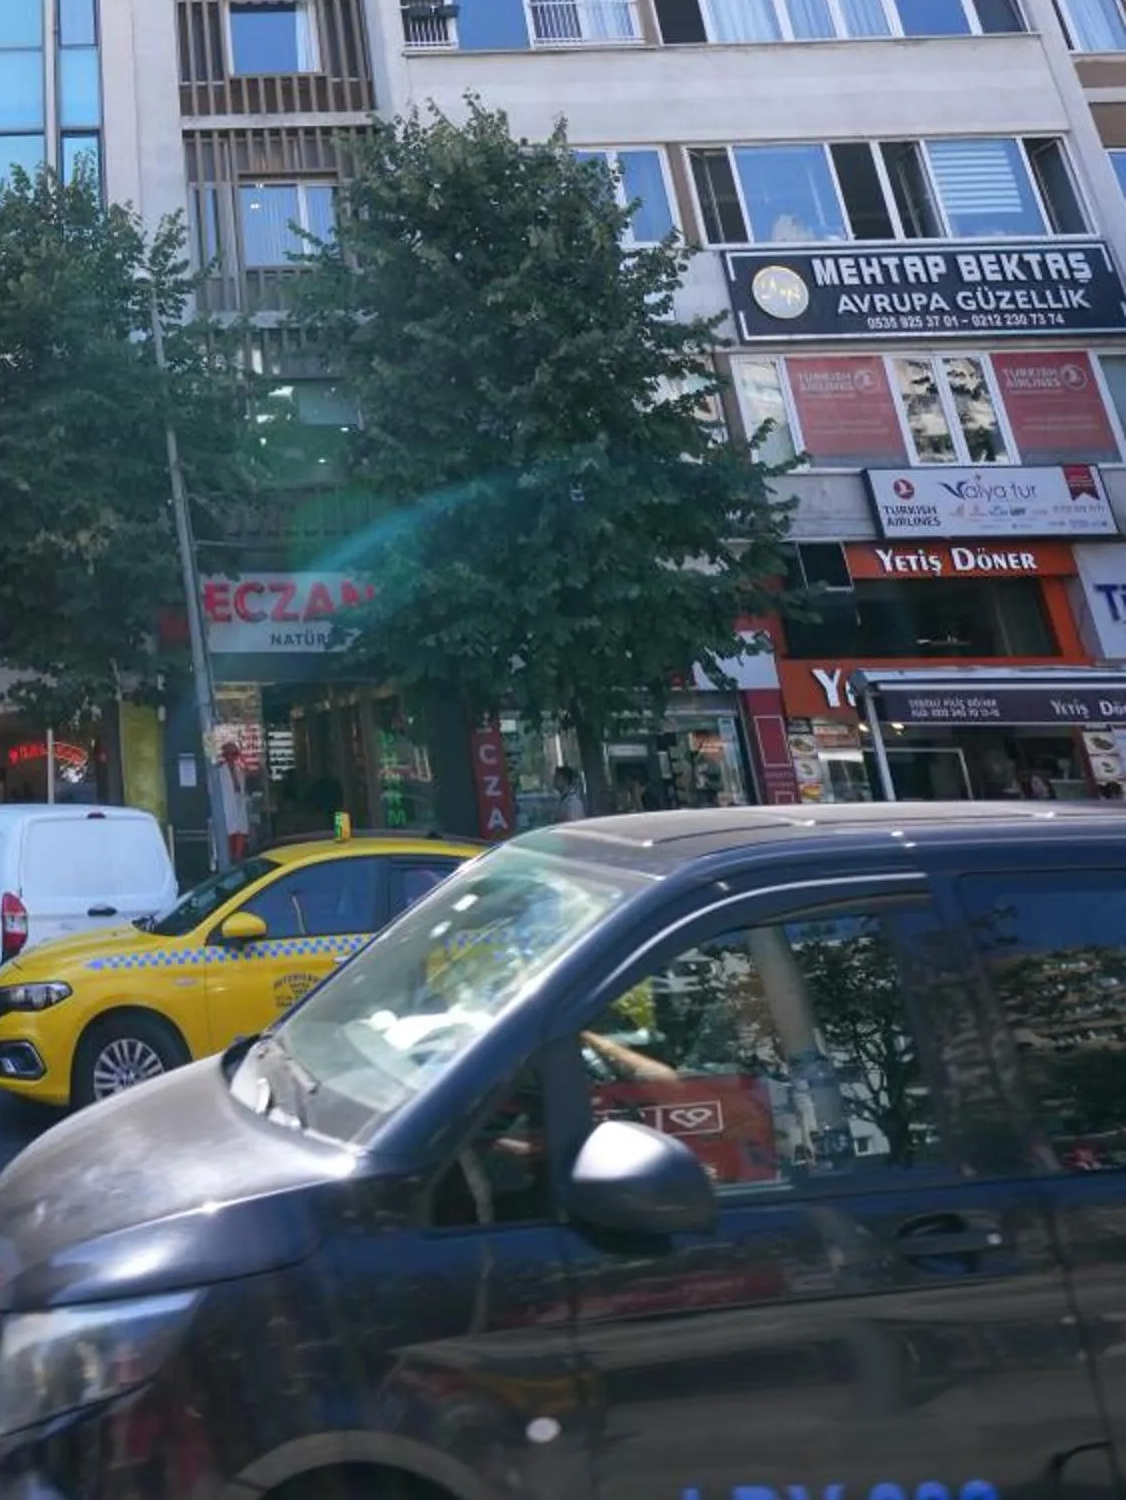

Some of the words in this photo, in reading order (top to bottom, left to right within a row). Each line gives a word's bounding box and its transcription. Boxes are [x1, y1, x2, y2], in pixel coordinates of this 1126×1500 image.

[811, 255, 948, 287] MEHTAP
[955, 252, 1093, 284] BEKTAŞ
[836, 292, 950, 315] AVRUPA
[955, 285, 1093, 311] GÜZELLİK
[973, 314, 1003, 327] 0212
